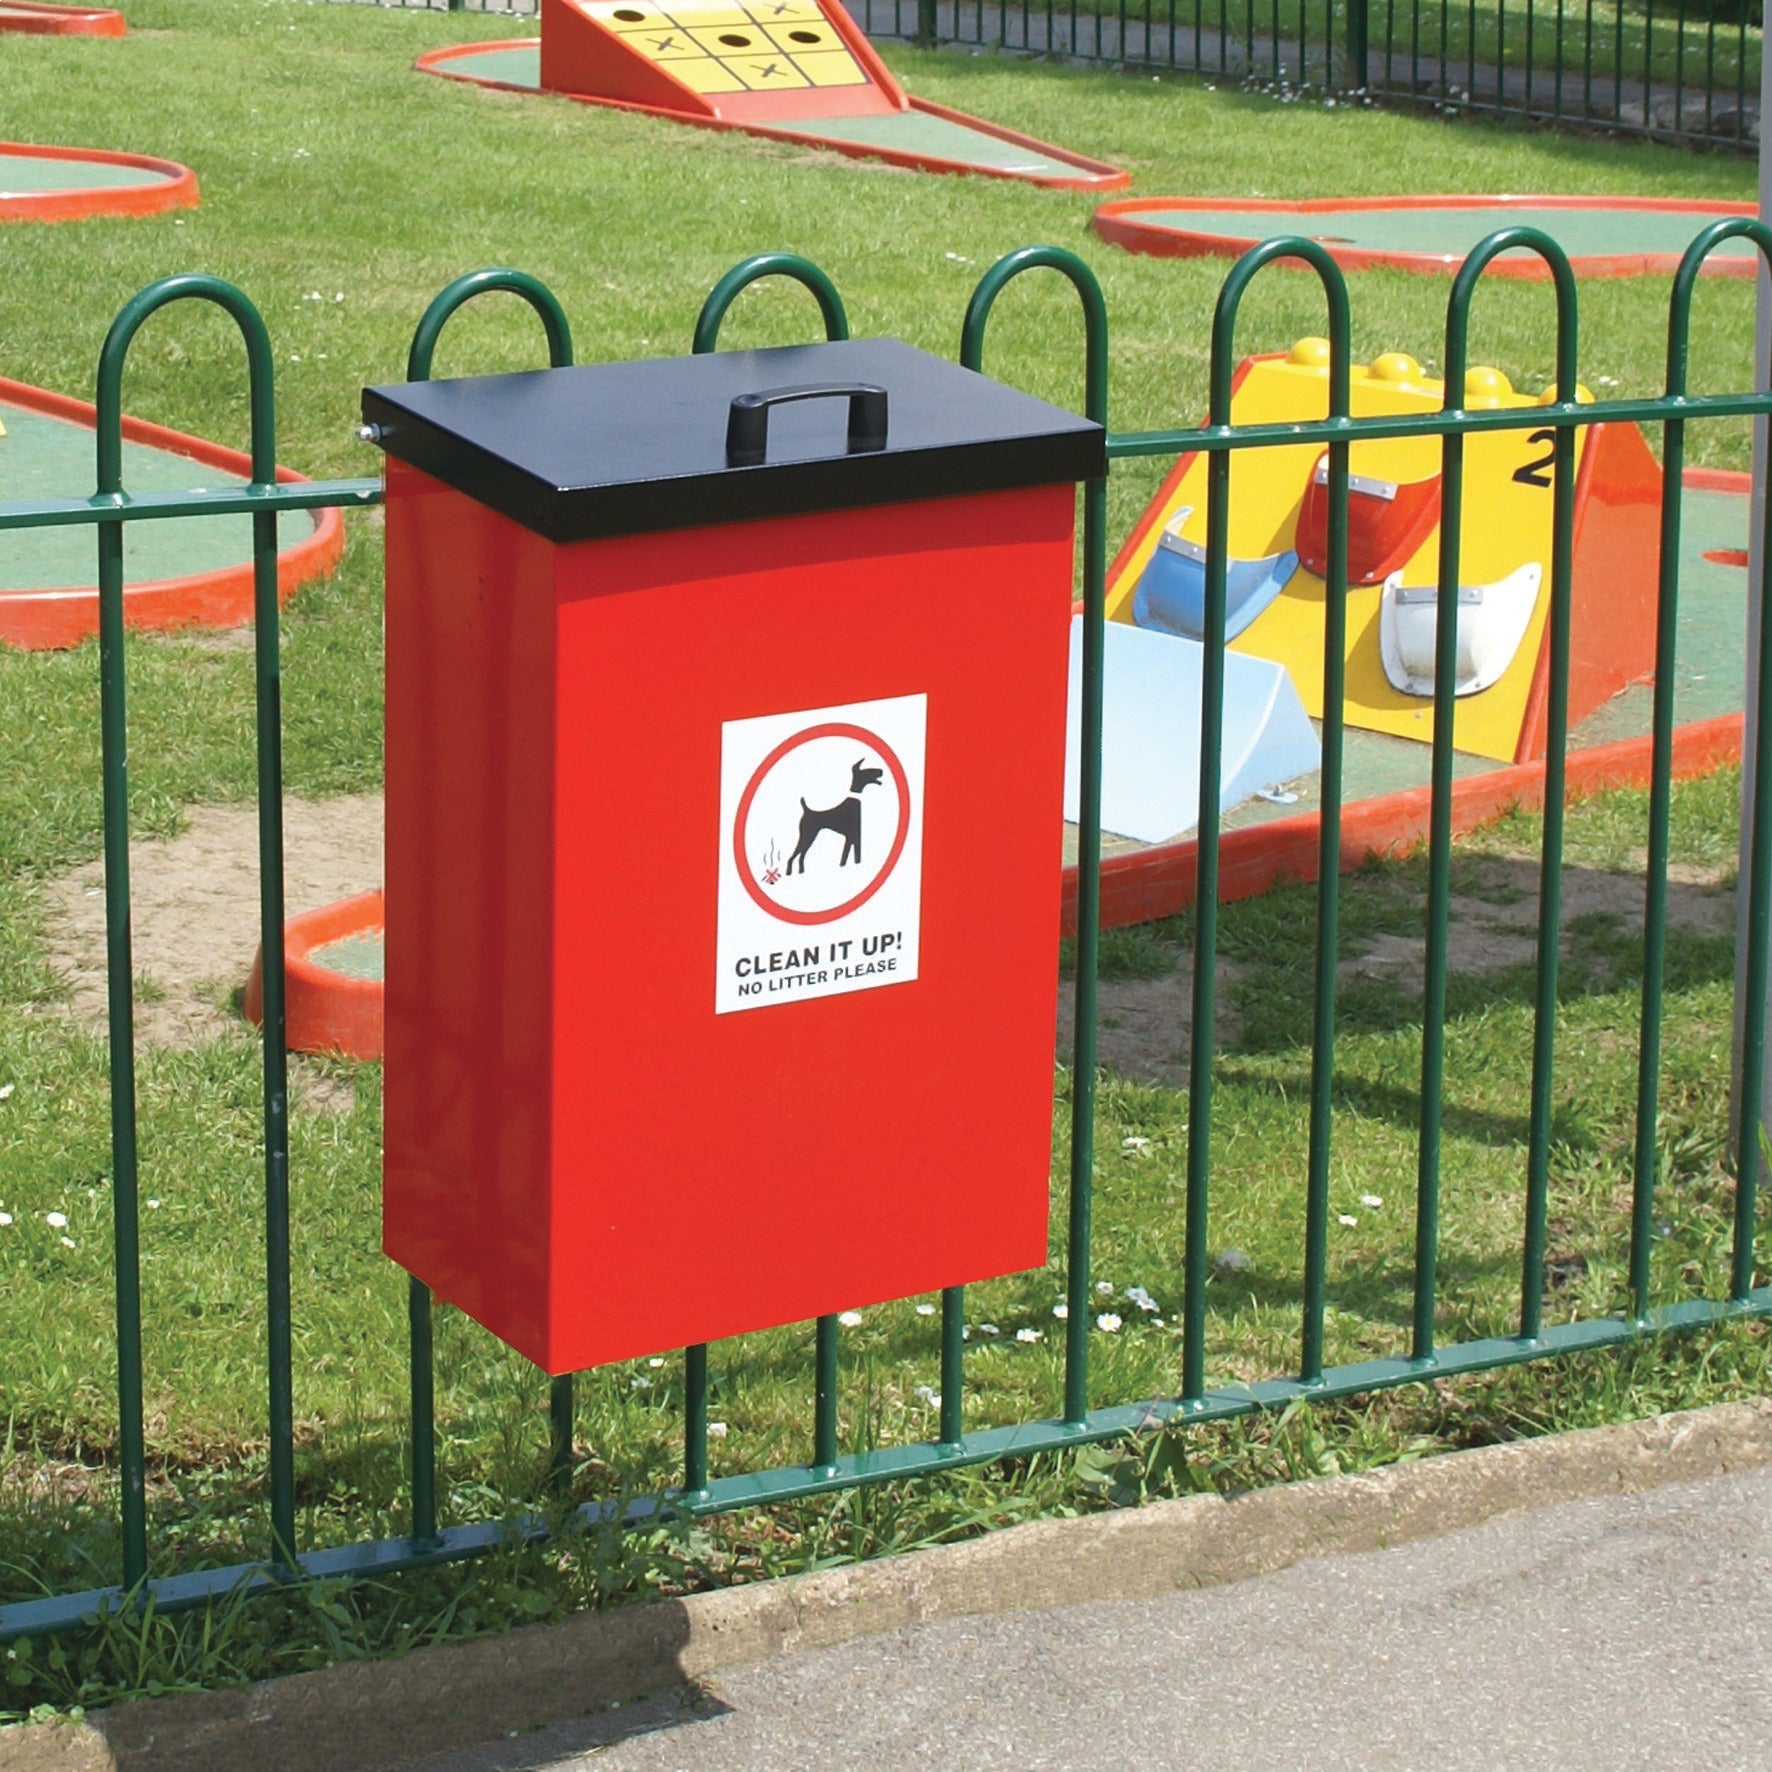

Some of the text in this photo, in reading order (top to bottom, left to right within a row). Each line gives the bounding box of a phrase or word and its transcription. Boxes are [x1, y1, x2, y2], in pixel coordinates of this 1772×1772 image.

[1512, 429, 1556, 488] 2
[735, 931, 902, 977] CLEAN IT UP!
[738, 957, 897, 996] NO LITTER PLEASE
